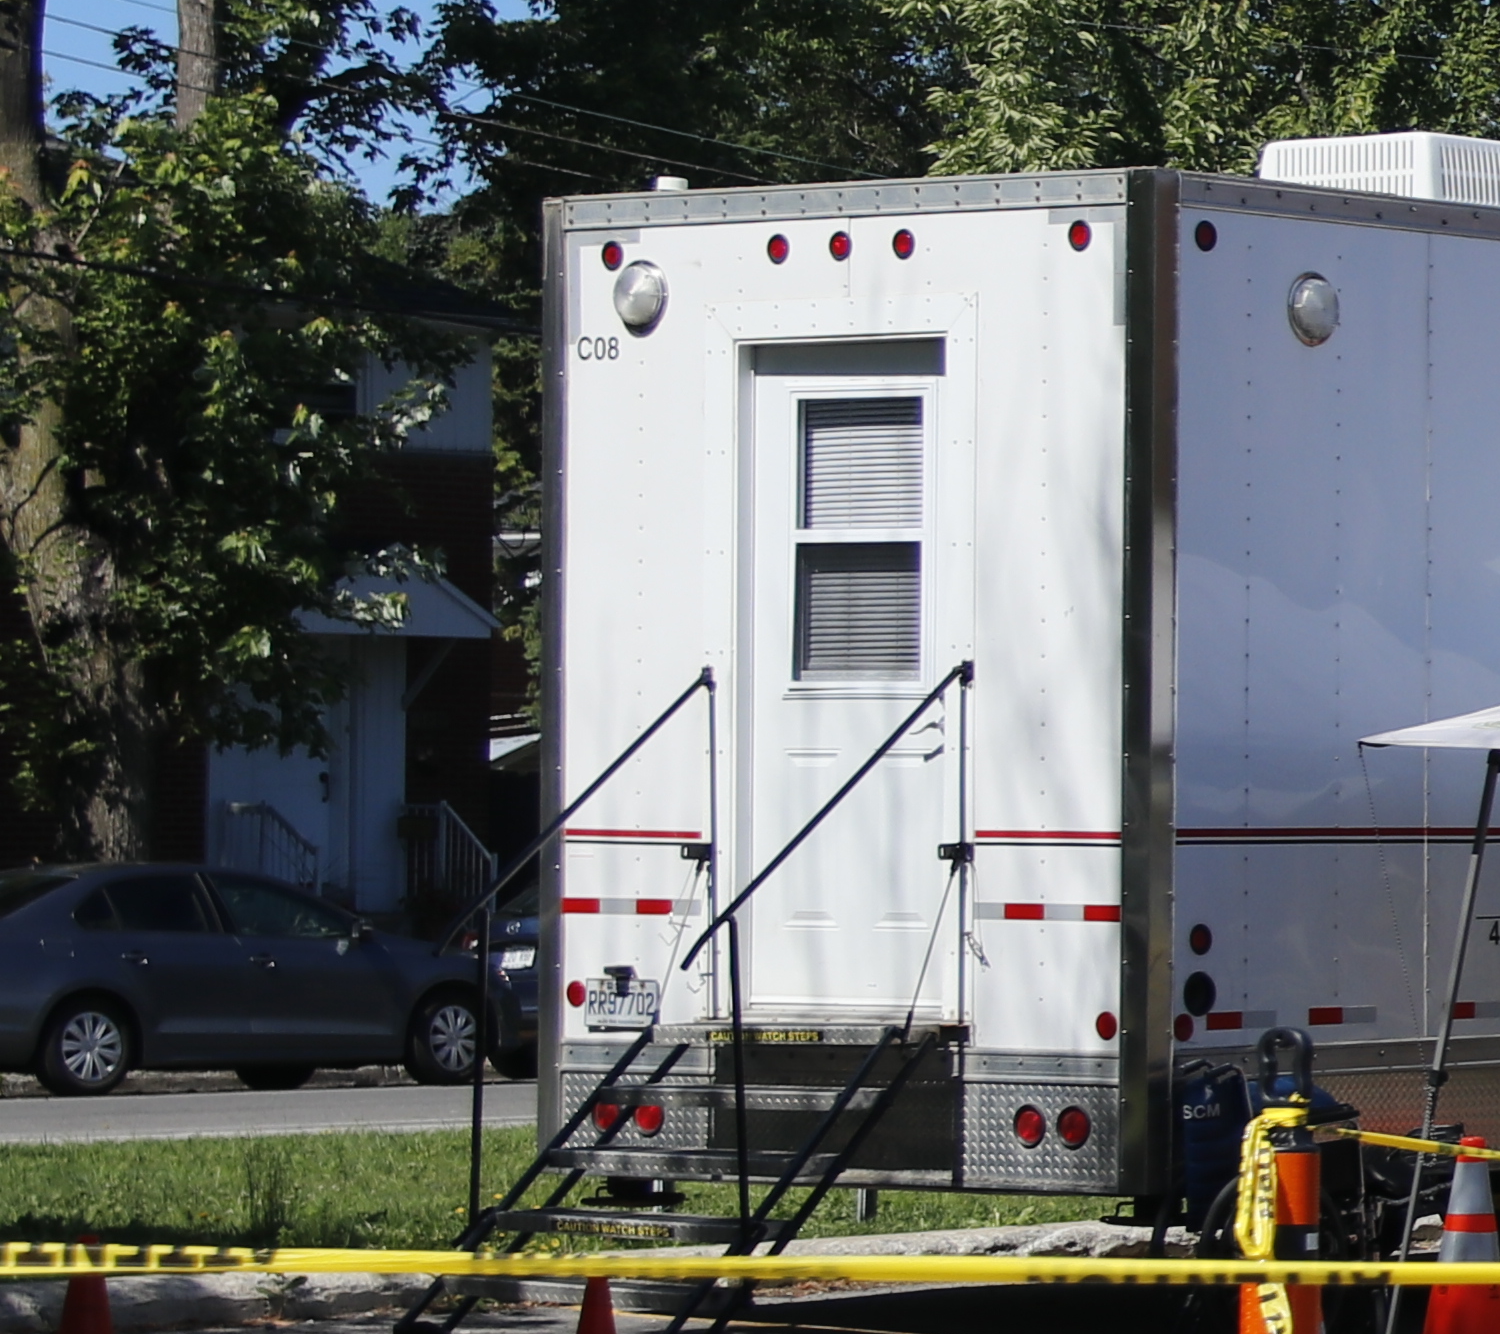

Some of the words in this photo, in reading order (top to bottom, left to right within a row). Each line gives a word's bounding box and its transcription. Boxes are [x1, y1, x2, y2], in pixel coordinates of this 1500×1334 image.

[577, 336, 620, 361] C08
[588, 991, 655, 1016] RR97702
[1183, 1103, 1221, 1119] SCM
